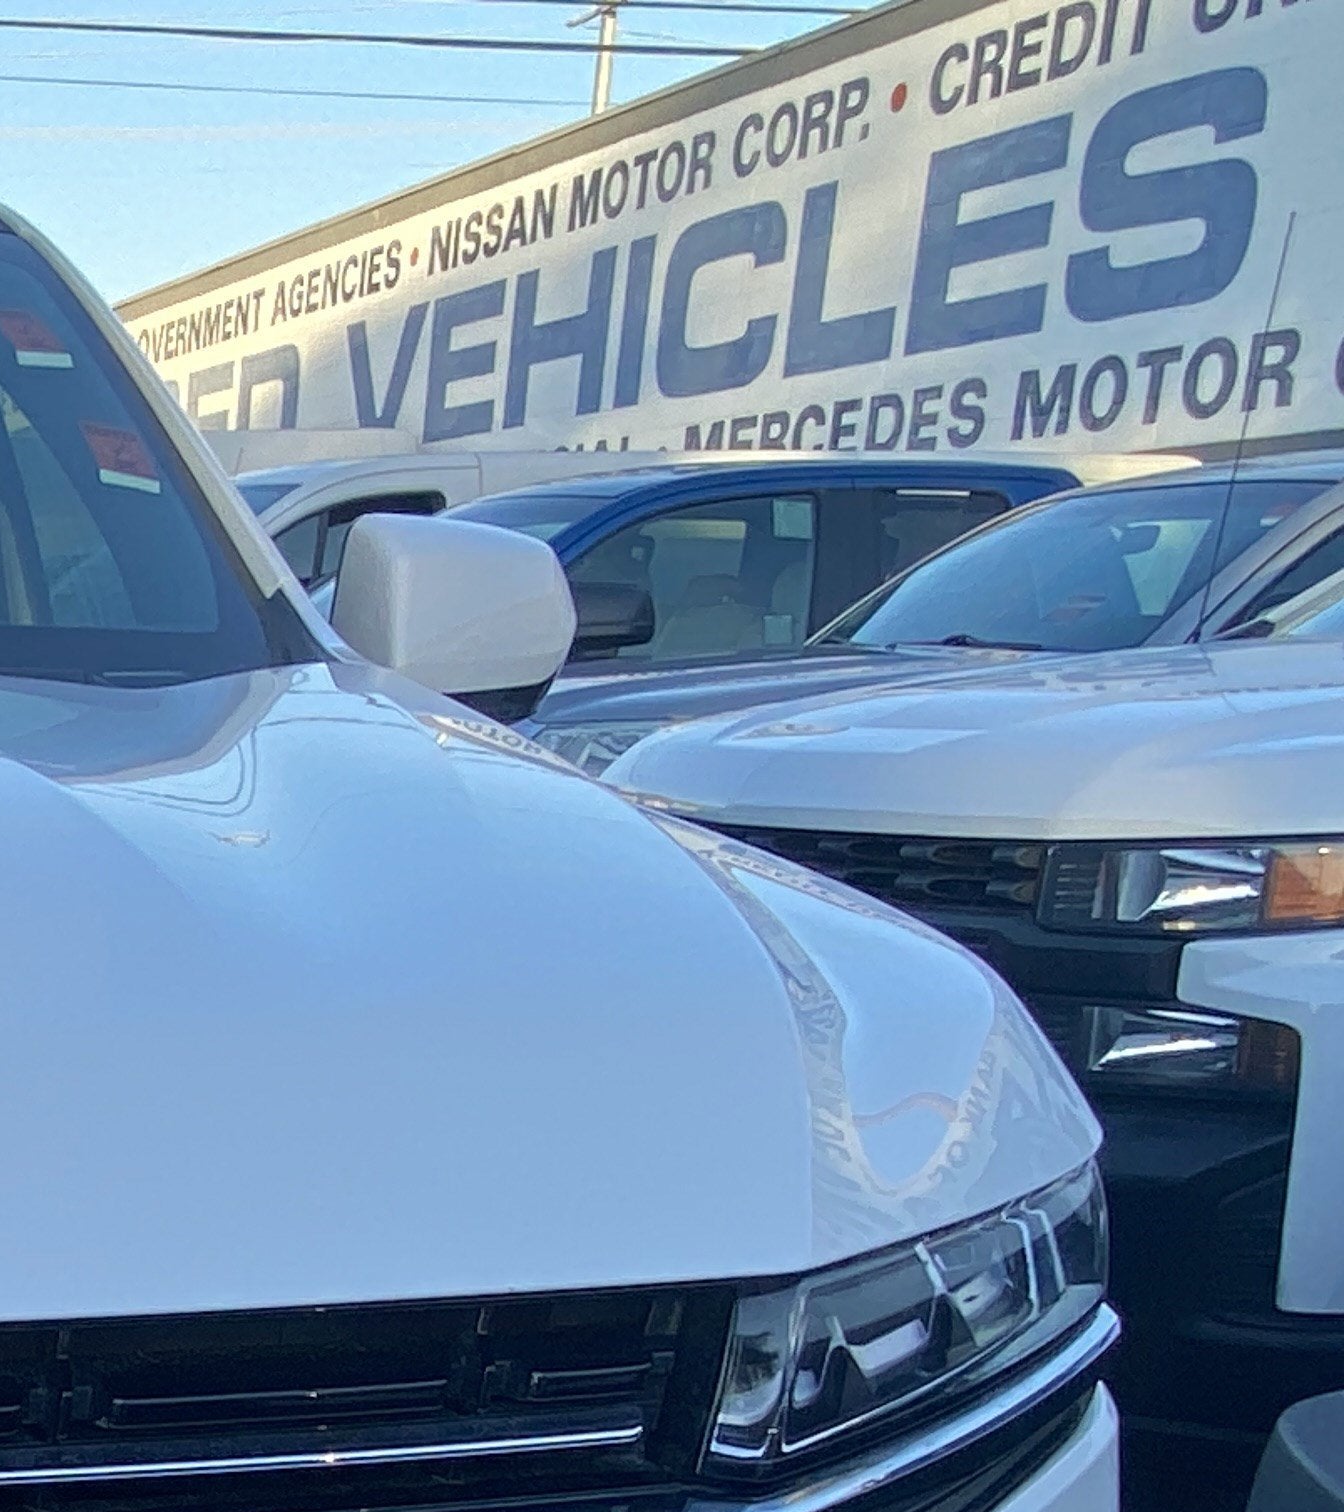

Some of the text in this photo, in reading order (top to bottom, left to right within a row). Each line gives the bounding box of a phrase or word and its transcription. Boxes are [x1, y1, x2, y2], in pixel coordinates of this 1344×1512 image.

[137, 287, 266, 363] OVERNMENT
[270, 240, 403, 326] AGENCIES
[427, 183, 559, 276] NISSAN
[567, 130, 716, 232] MOTOR
[732, 75, 871, 178] CORP.
[164, 65, 1269, 443] ED VEHICLES
[1009, 327, 1302, 442] MOTOR
